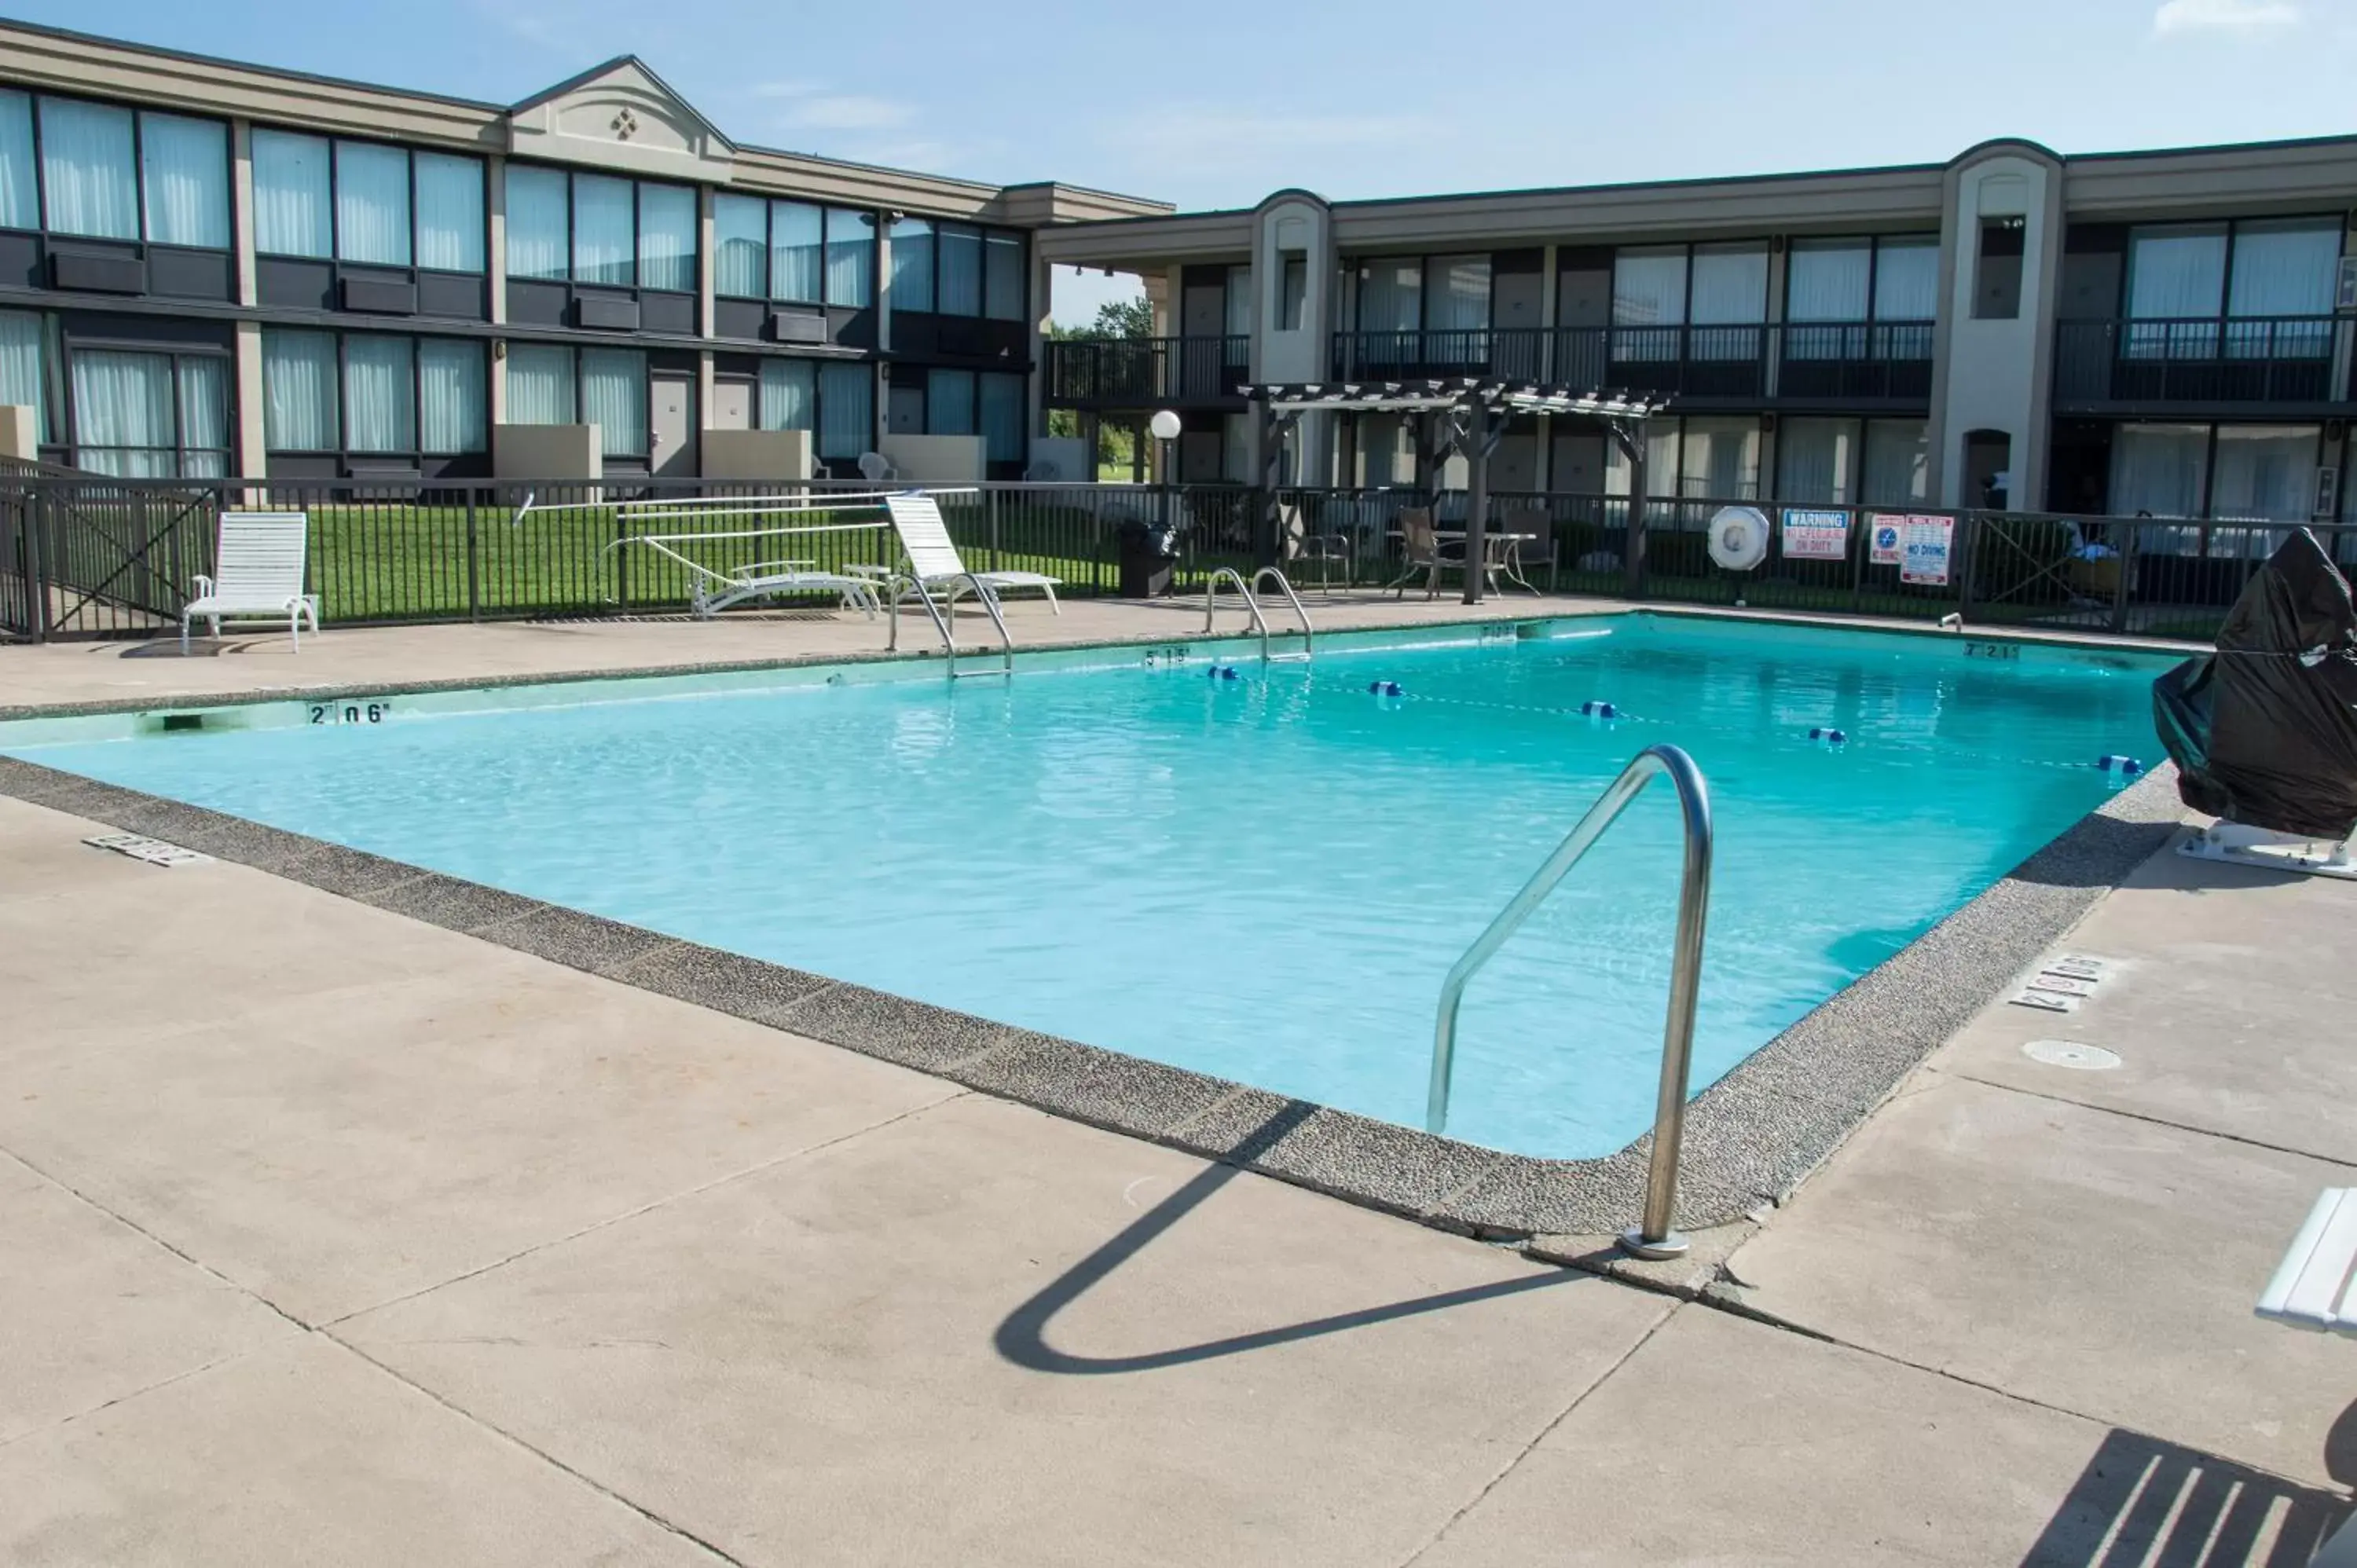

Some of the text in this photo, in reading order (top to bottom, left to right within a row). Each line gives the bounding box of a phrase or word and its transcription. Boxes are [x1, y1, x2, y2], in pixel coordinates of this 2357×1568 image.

[1790, 513, 1842, 527] WARNING
[1810, 540, 1831, 551] DUTY
[1908, 544, 1946, 557] NO DIVING
